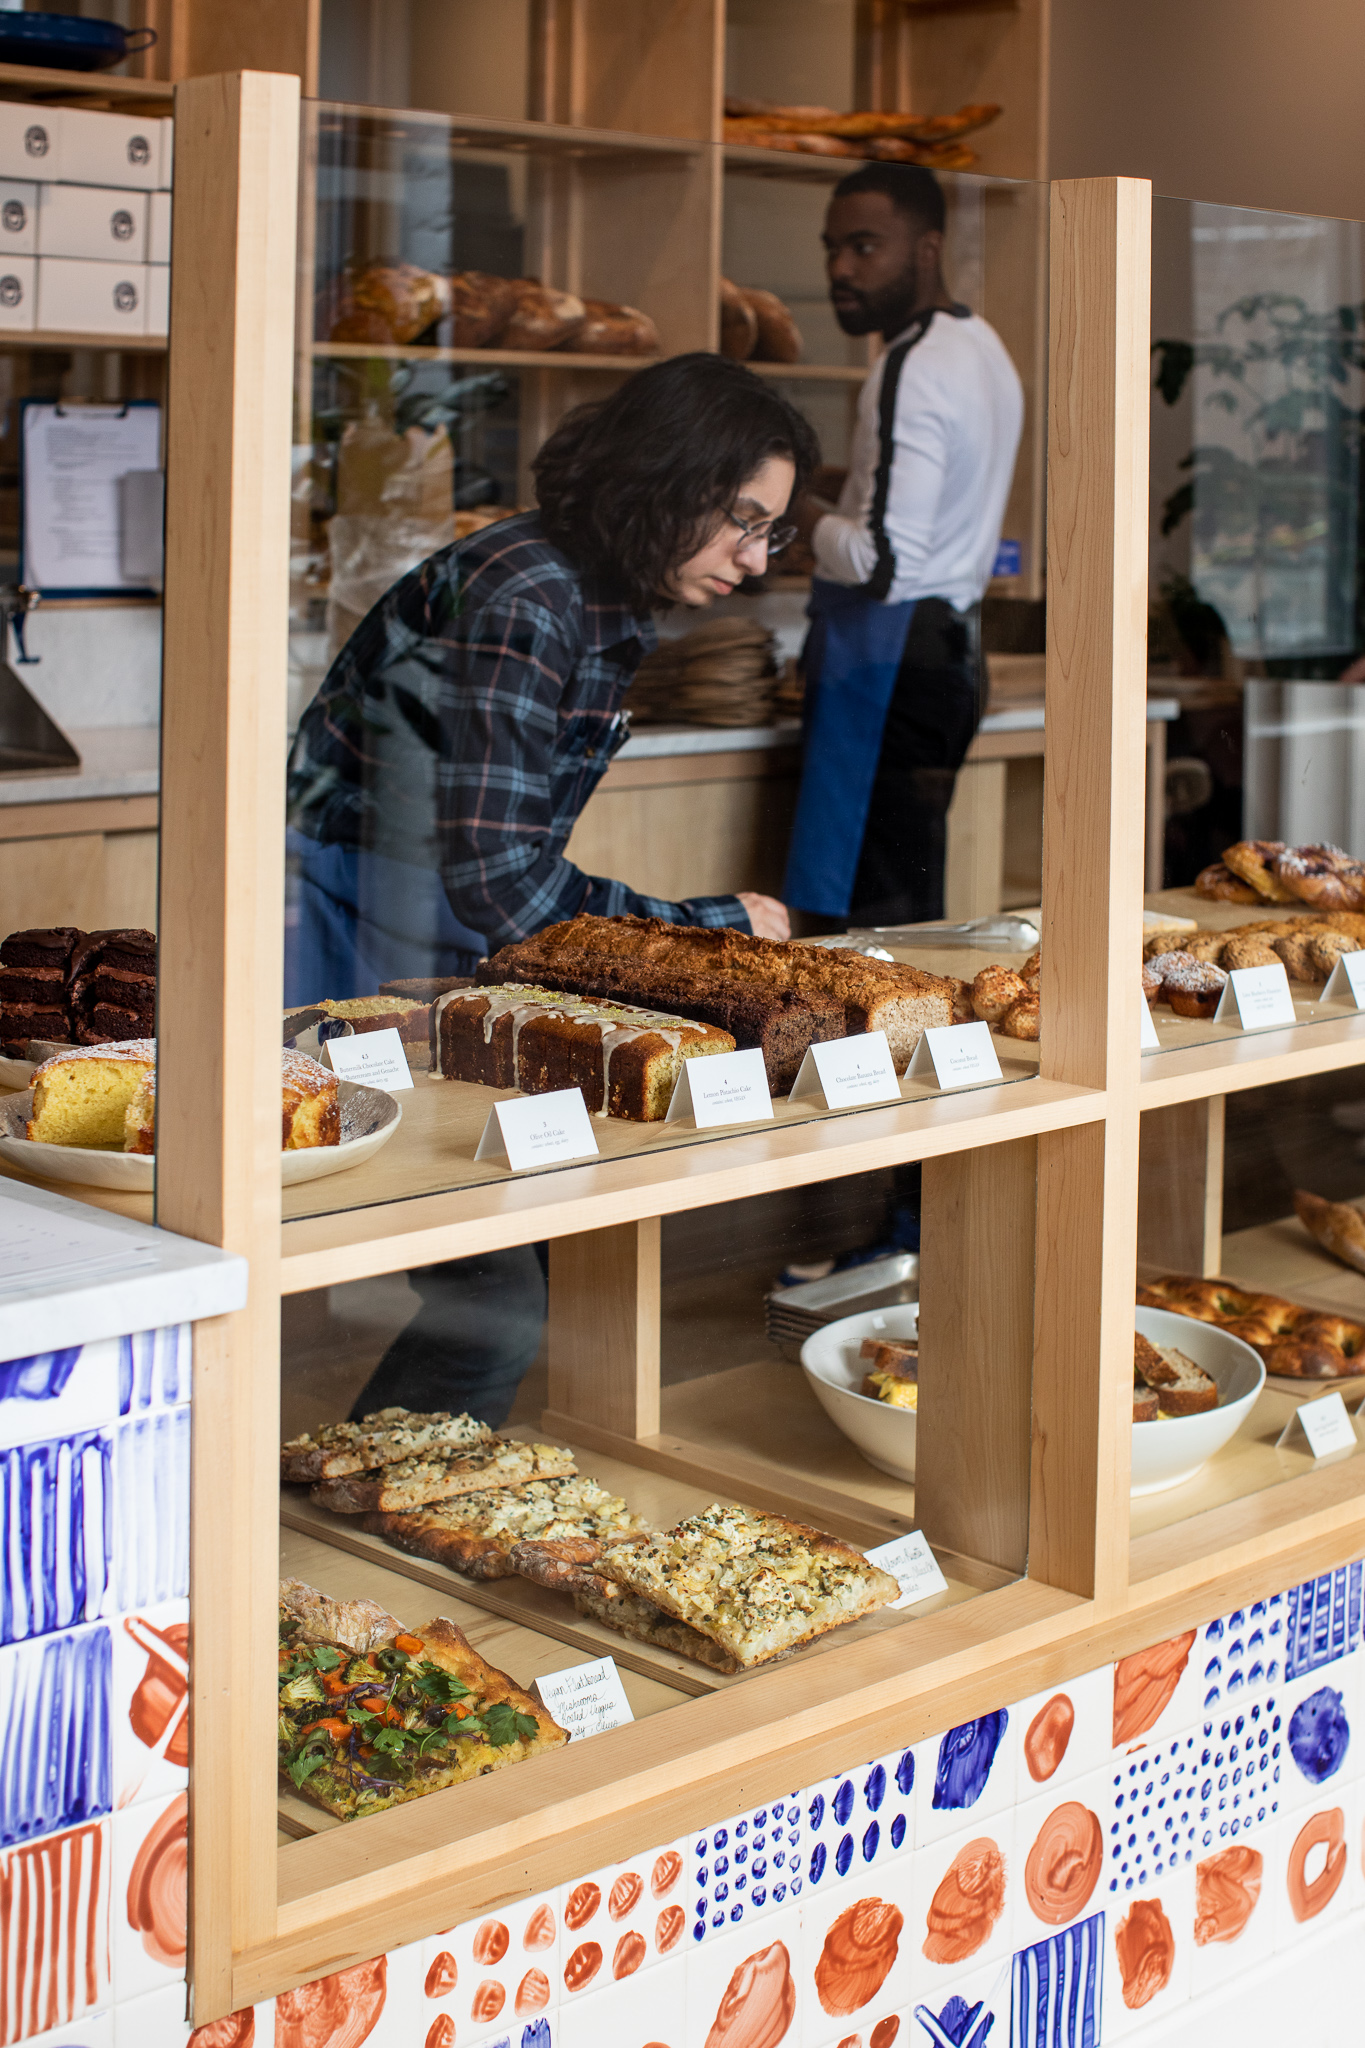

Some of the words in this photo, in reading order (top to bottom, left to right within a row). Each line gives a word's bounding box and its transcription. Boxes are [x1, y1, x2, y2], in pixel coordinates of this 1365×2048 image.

[362, 1061, 383, 1069] Chocolate
[703, 1091, 720, 1099] Lemon
[719, 1088, 740, 1096] Pistachio
[739, 1085, 752, 1093] Cake
[529, 1133, 543, 1141] Olive
[543, 1130, 553, 1138] Oil
[552, 1128, 565, 1136] Cake
[542, 1684, 567, 1707] Vegan
[565, 1665, 611, 1693] Flatbread
